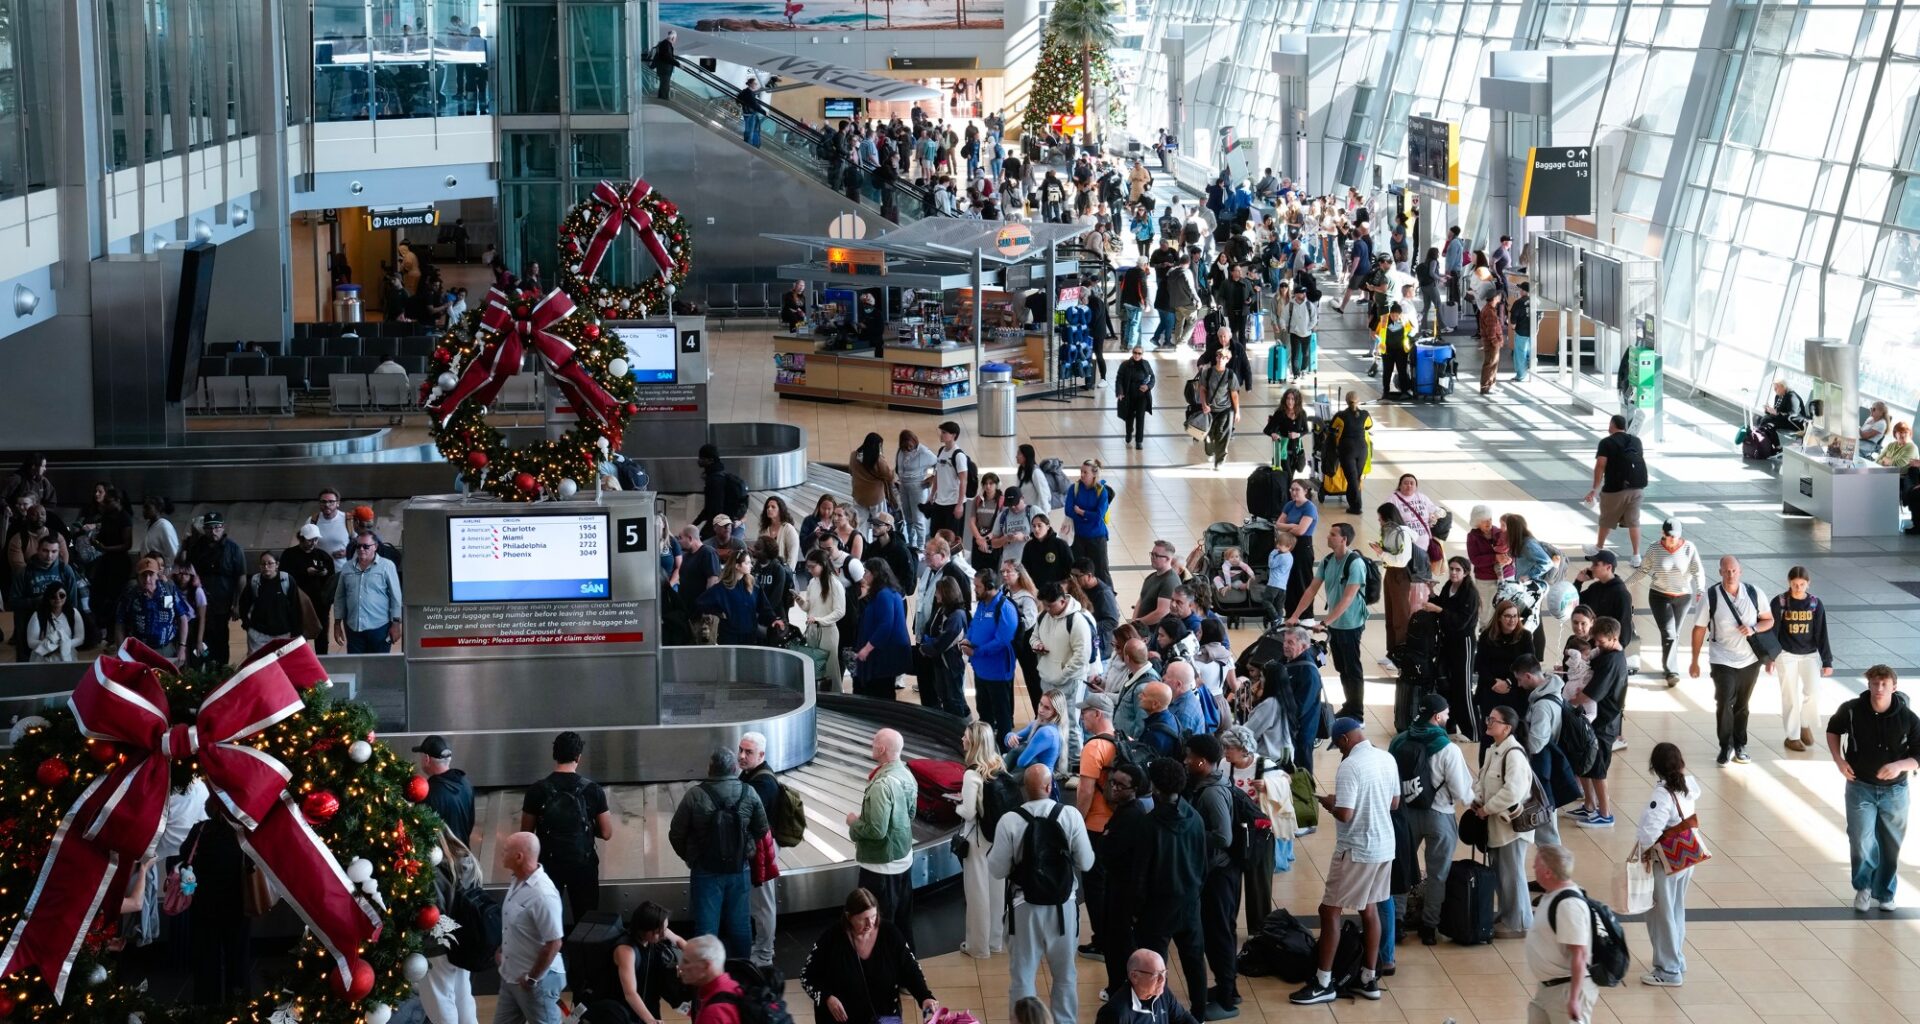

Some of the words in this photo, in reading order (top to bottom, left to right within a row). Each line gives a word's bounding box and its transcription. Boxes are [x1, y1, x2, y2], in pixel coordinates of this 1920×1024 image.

[1535, 161, 1566, 170] Baggage
[1567, 160, 1588, 168] Claim
[1576, 170, 1588, 178] 1-3
[383, 215, 423, 226] Restrooms
[686, 334, 696, 349] 4
[626, 525, 639, 546] 5
[462, 612, 491, 620] luggage
[559, 609, 584, 618] leaving
[423, 622, 444, 630] Claim
[445, 622, 464, 631] large
[480, 621, 511, 629] over-size
[511, 620, 538, 628] articles
[560, 619, 592, 627] over-size
[592, 619, 624, 627] baggage
[1788, 623, 1810, 634] 1971
